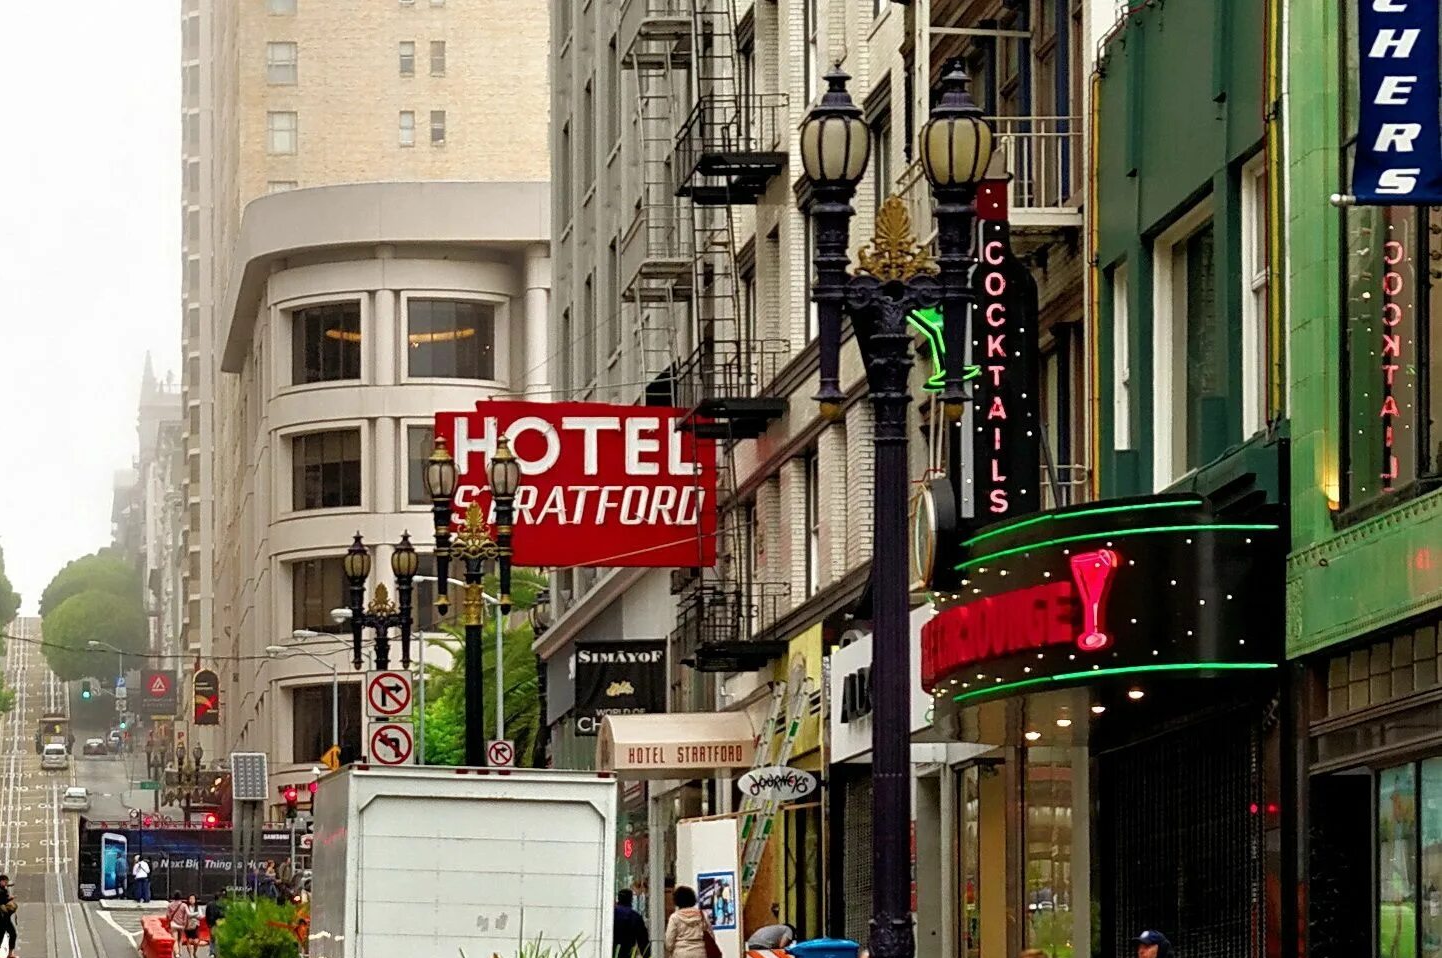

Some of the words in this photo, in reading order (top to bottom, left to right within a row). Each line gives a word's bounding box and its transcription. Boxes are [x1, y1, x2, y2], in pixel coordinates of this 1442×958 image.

[984, 241, 1009, 513] COCKTAILS
[453, 416, 704, 476] HOTEL
[628, 747, 666, 764] HOTEL
[677, 745, 743, 763] STRATFORD
[204, 859, 232, 871] Thing
